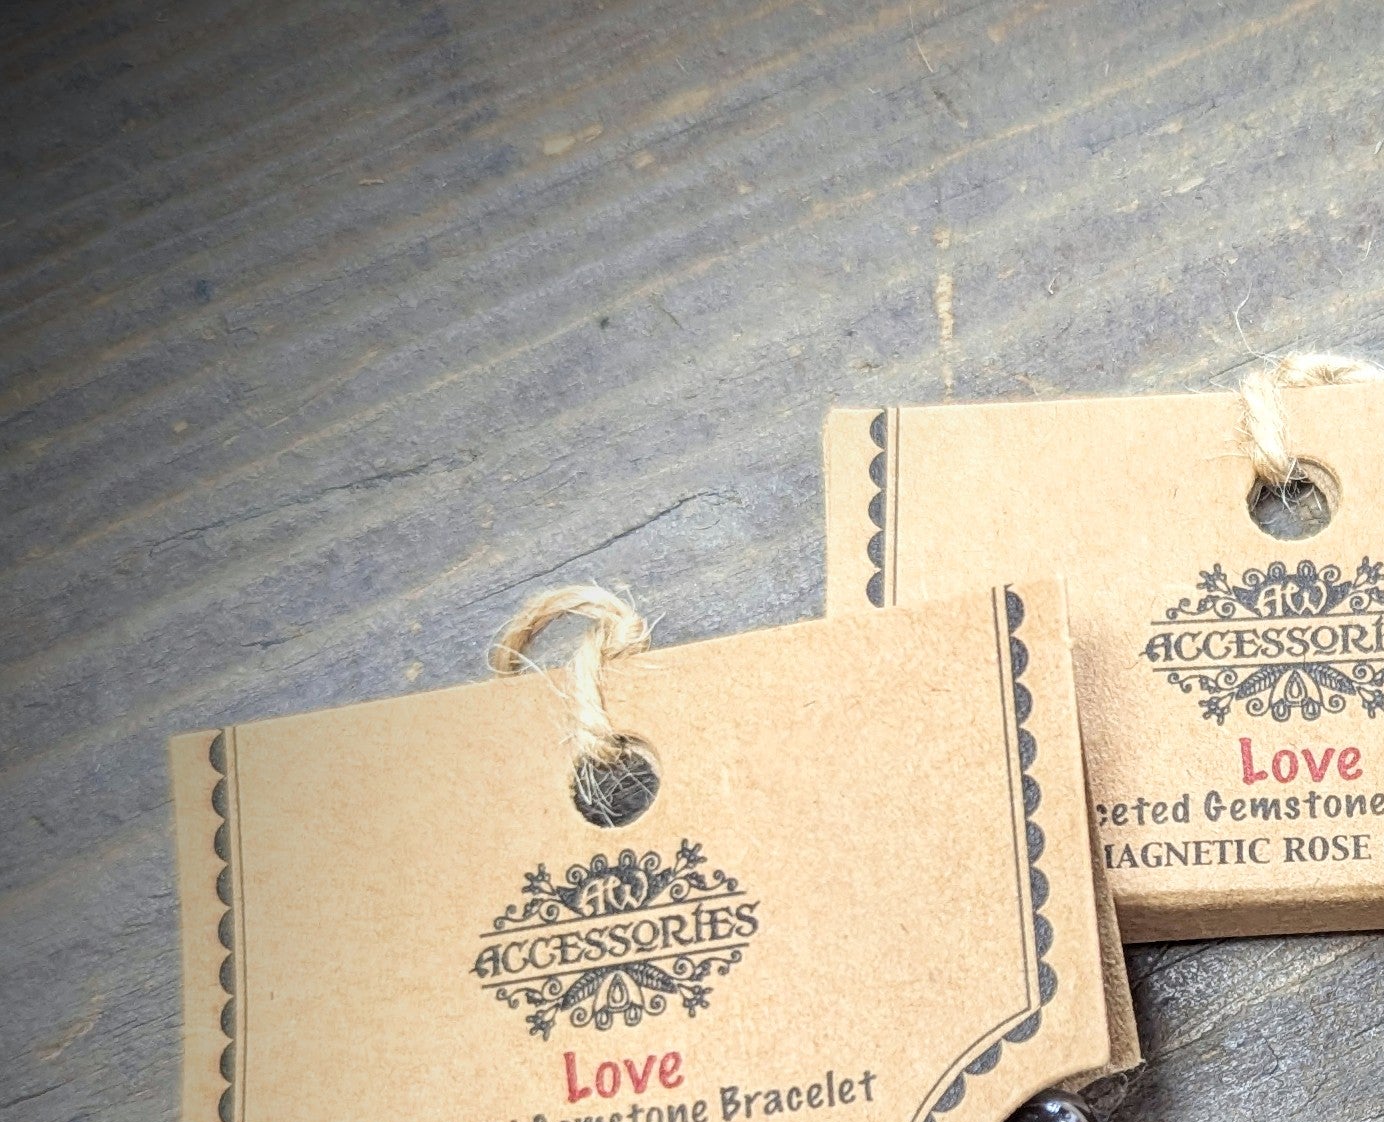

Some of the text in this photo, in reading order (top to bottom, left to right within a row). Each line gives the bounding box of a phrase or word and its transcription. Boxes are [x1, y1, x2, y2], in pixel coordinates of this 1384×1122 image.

[1239, 737, 1364, 785] Love
[1096, 793, 1190, 827] eted
[1283, 834, 1372, 862] ROSE
[469, 901, 760, 978] ACCESSORIES
[563, 1051, 685, 1103] Love
[720, 1070, 877, 1121] Bracelet
